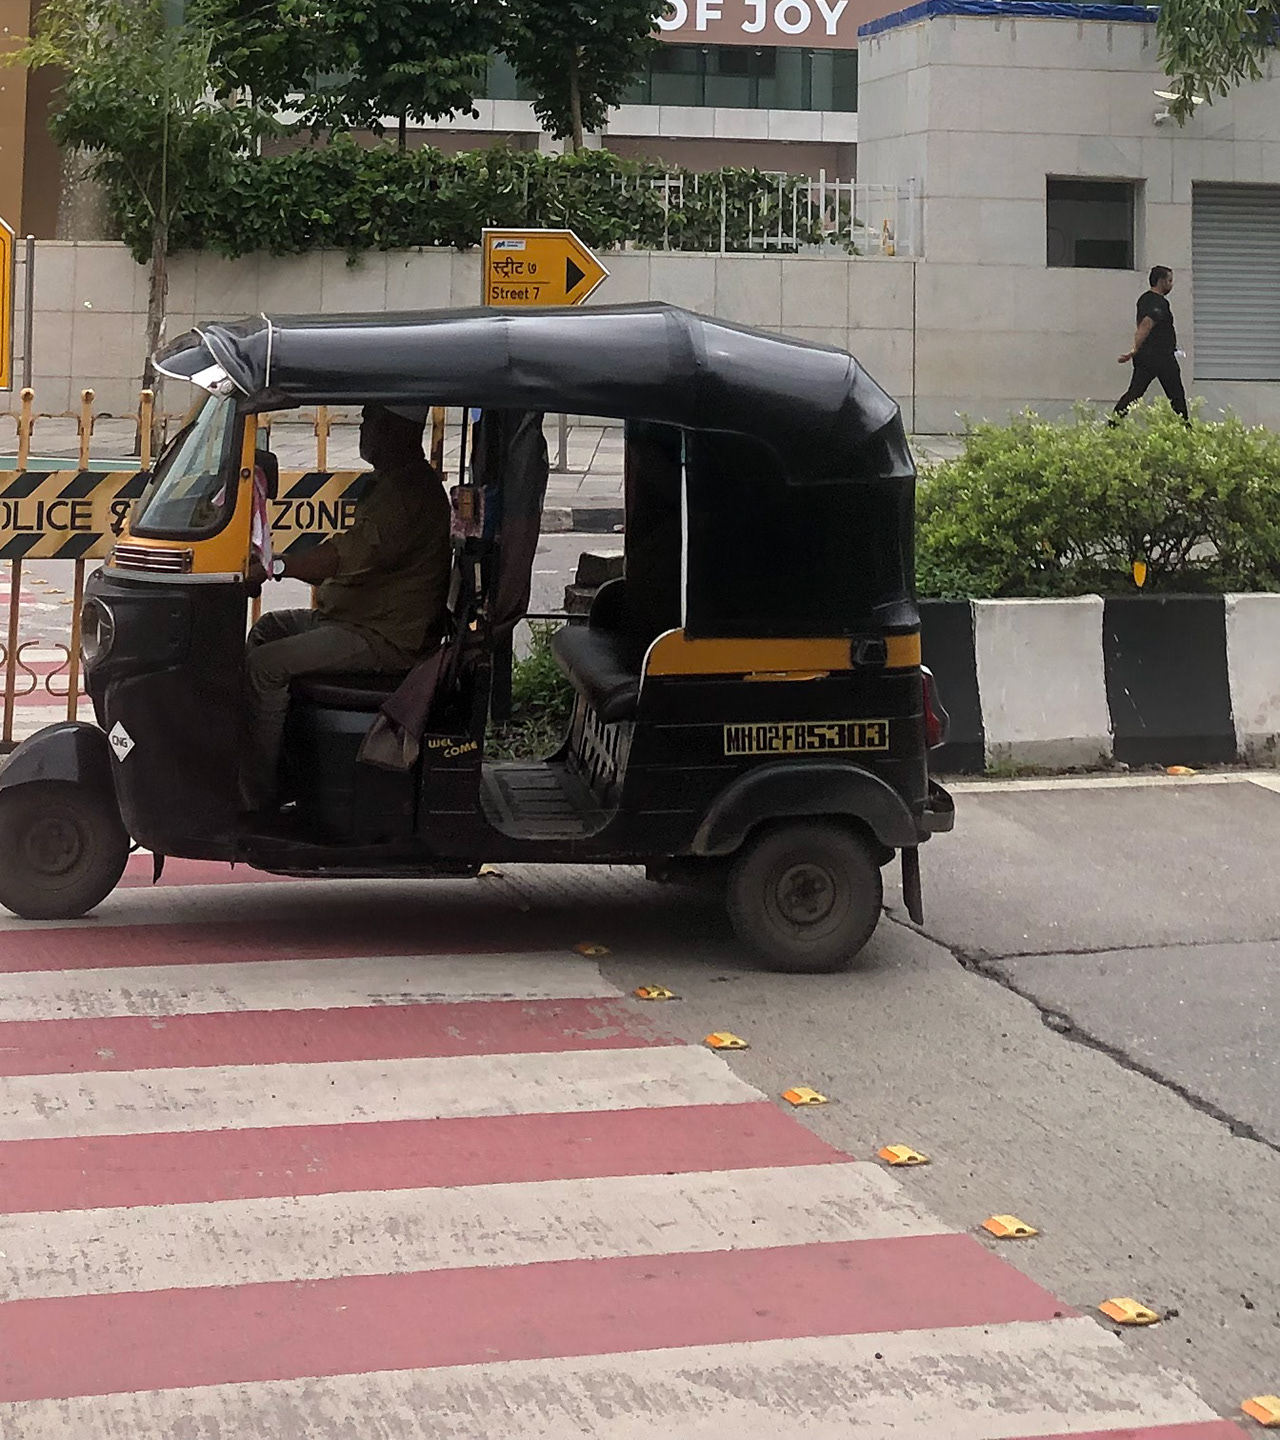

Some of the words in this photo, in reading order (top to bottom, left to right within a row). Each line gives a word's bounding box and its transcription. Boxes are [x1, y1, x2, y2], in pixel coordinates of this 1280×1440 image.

[527, 261, 538, 275] ७
[491, 286, 530, 301] Street
[532, 286, 541, 301] 7
[271, 499, 358, 531] ZONE
[443, 740, 478, 758] COME
